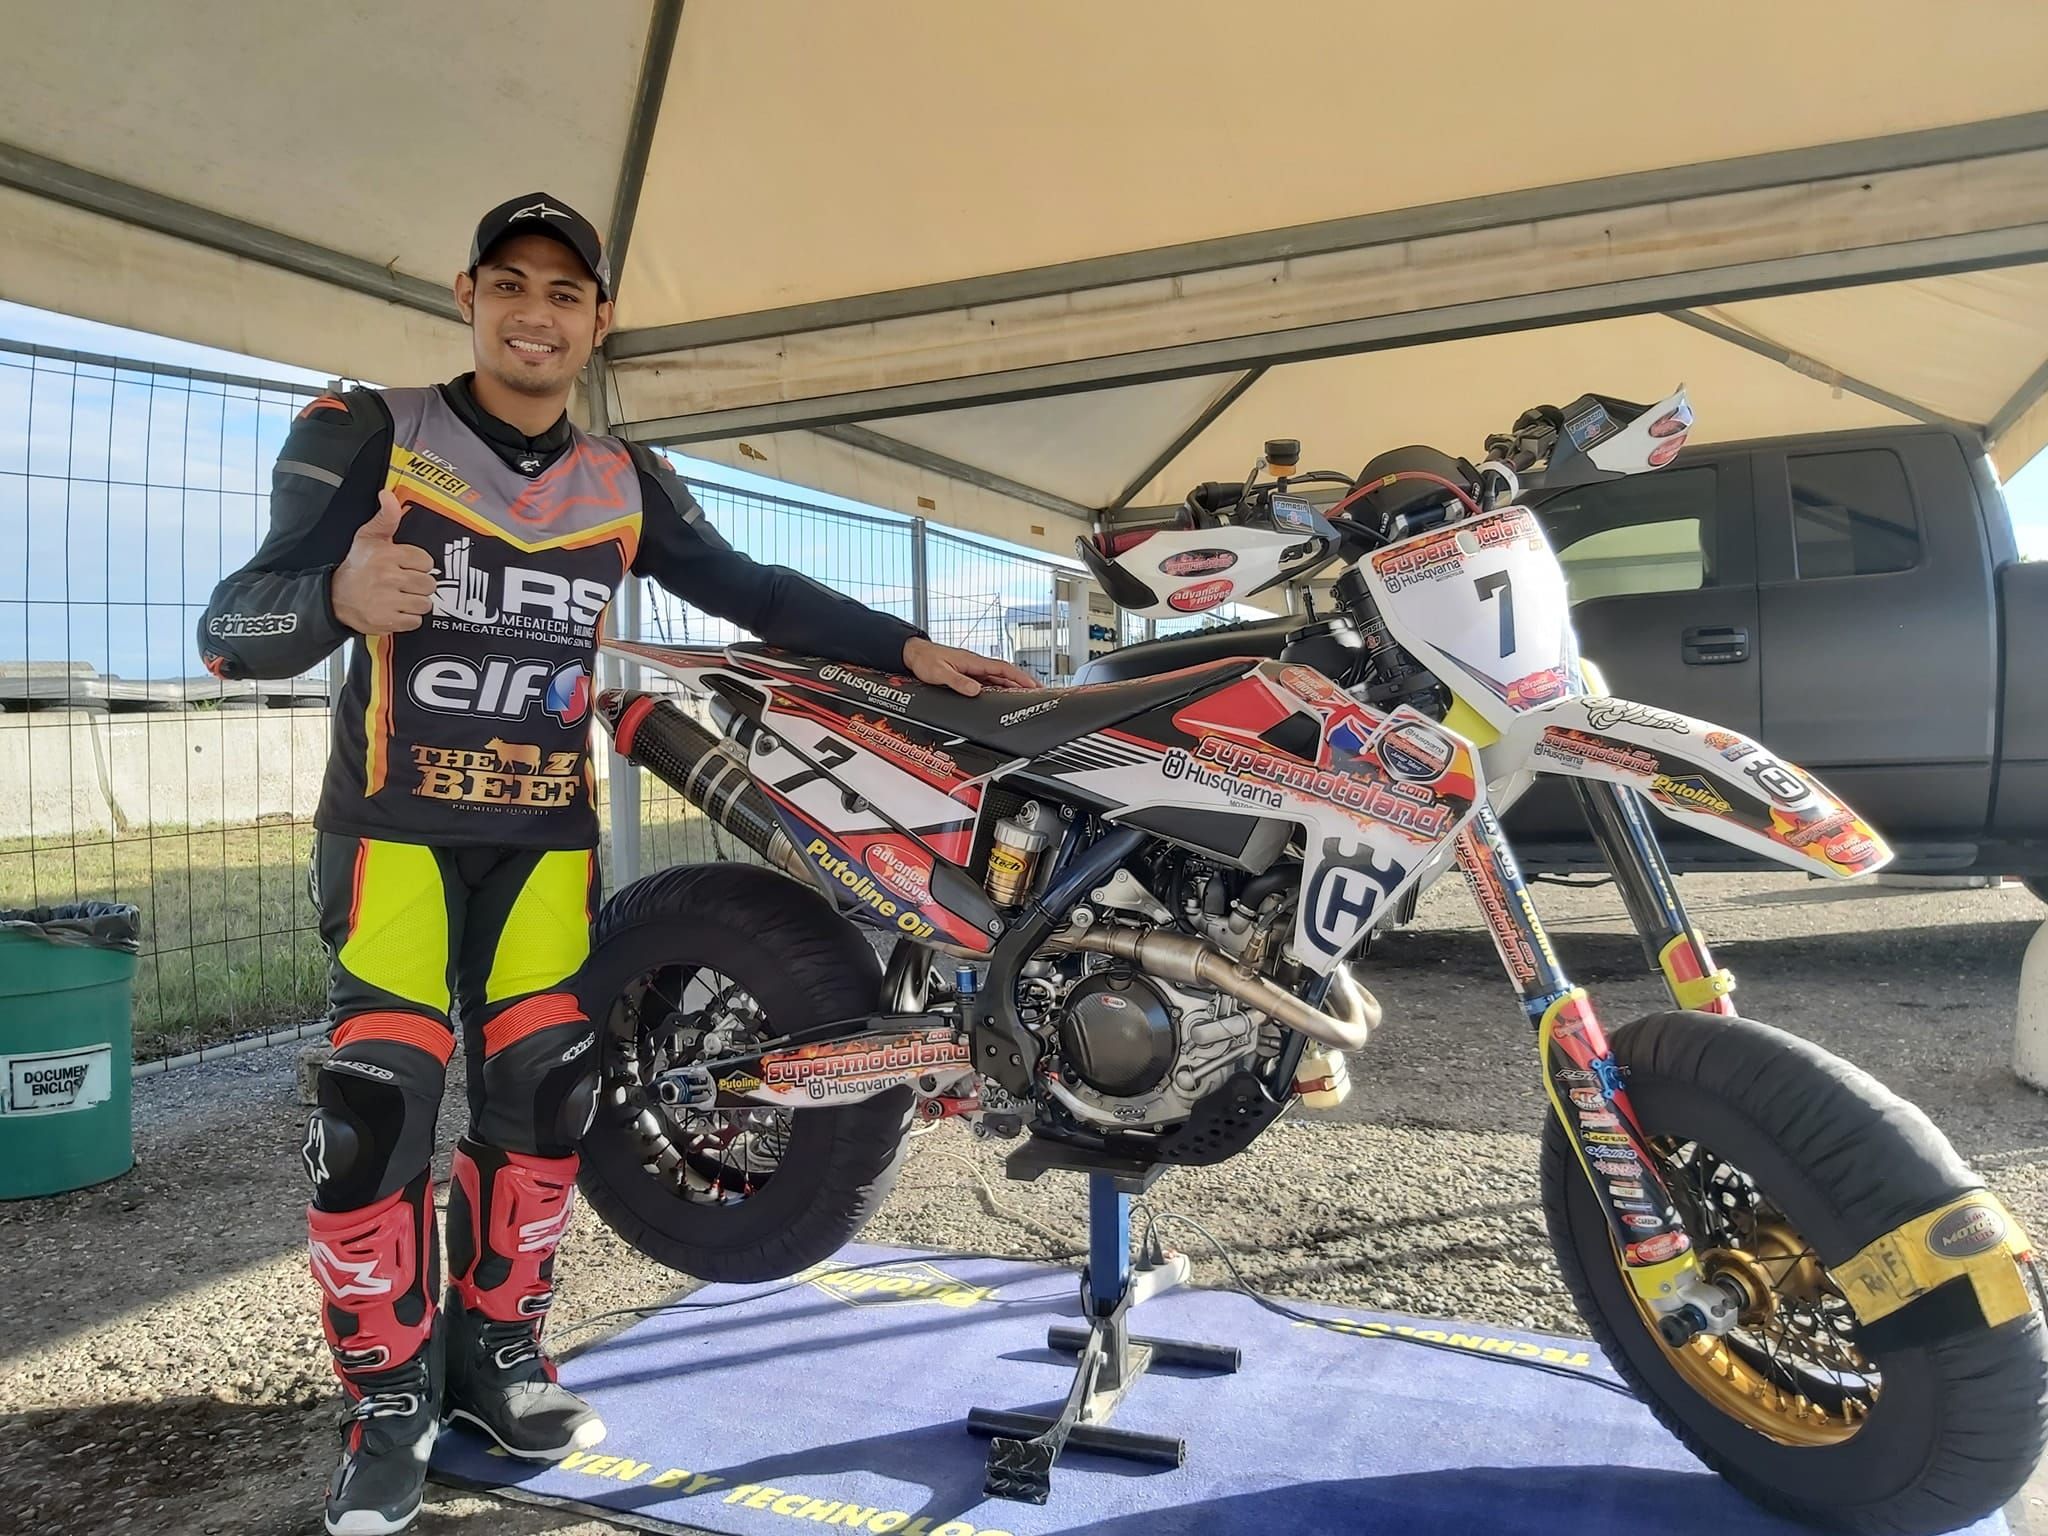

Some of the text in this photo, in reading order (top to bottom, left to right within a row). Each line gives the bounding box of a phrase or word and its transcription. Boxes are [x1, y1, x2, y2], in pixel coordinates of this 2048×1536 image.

[1174, 585, 1221, 601] advance
[1401, 559, 1461, 588] Husqvarna
[502, 566, 611, 626] RS
[1197, 590, 1232, 605] moves
[1473, 569, 1516, 659] 7
[432, 620, 450, 630] RS
[452, 622, 523, 639] MEGATECH
[502, 614, 569, 634] MEGATECH
[412, 660, 550, 716] elf
[836, 670, 912, 705] Husqvarna
[410, 744, 496, 772] THE
[411, 765, 580, 808] BEEF
[1185, 762, 1284, 810] Husqvarna
[1197, 736, 1450, 837] supermotoland
[1393, 782, 1432, 801] .com
[1654, 774, 1731, 812] Putoline
[872, 845, 926, 886] advance
[805, 838, 935, 938] Putoline Oil
[891, 871, 934, 906] moves
[1455, 830, 1536, 980] upermotoland
[767, 1040, 970, 1084] supermotoland
[718, 1077, 761, 1091] Putoline
[558, 1451, 652, 1483] VEN
[647, 1467, 724, 1494] BY
